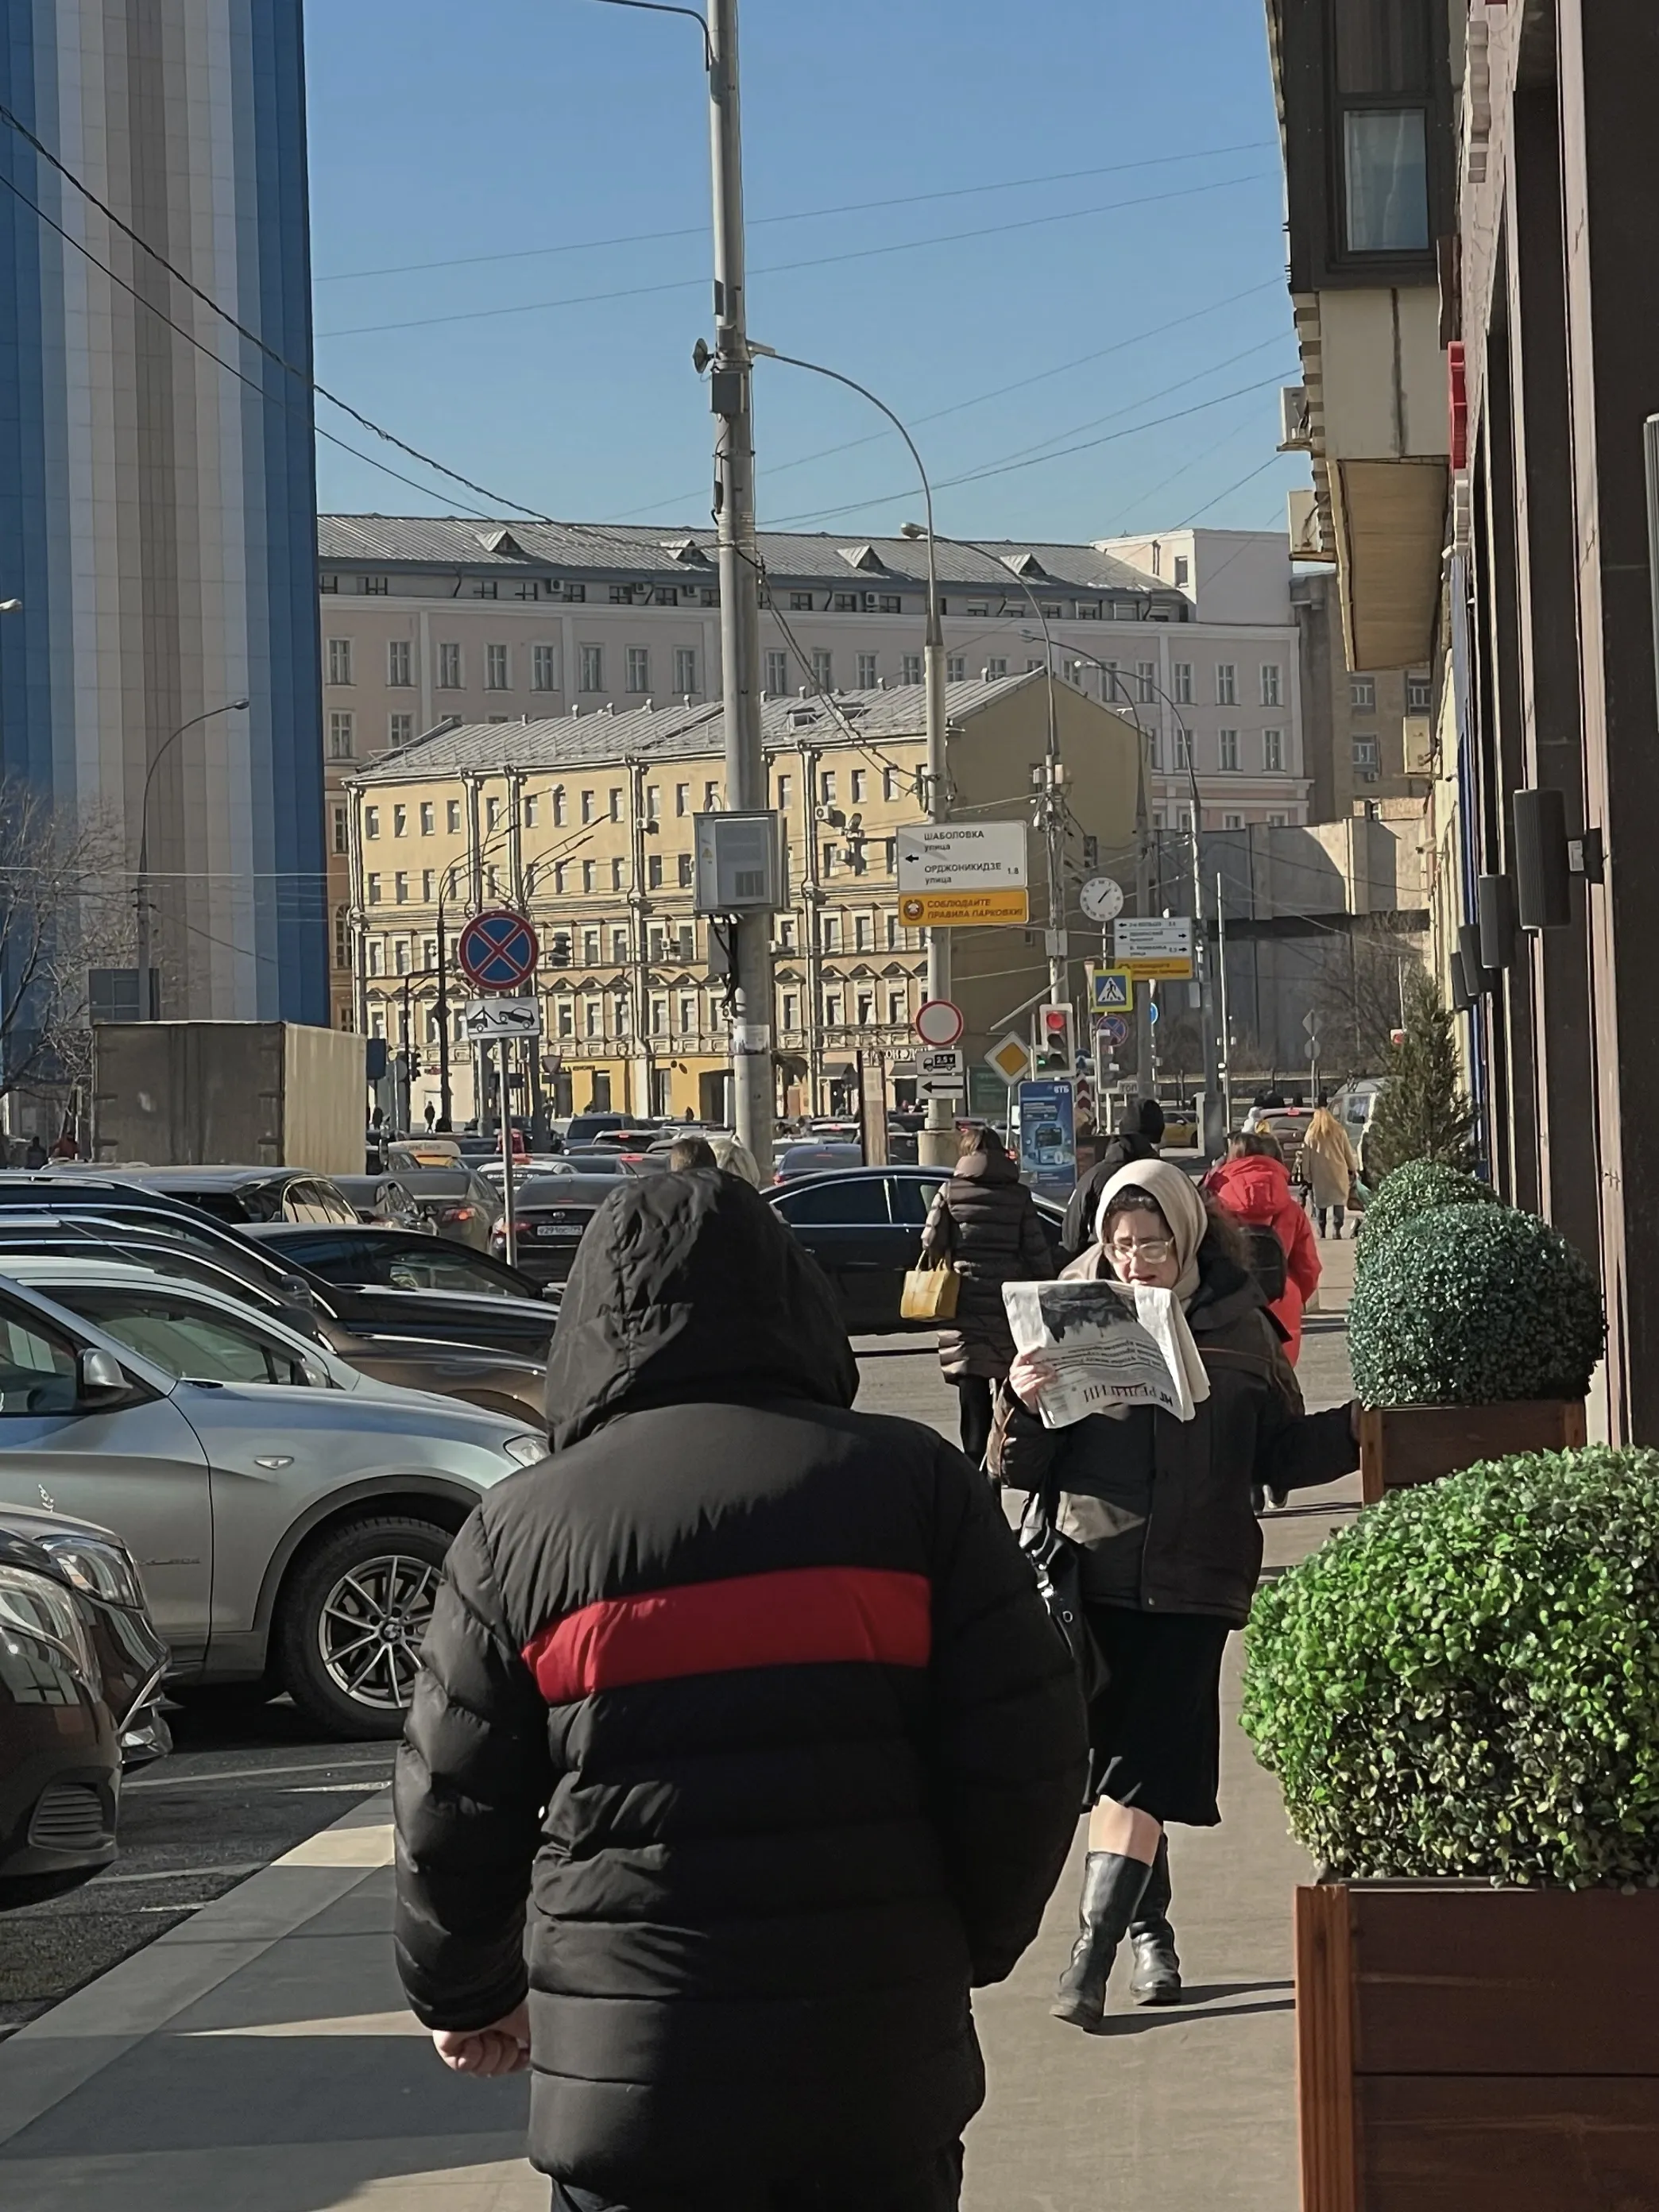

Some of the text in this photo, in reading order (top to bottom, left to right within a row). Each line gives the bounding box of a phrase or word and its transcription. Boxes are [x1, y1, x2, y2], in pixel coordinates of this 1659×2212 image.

[924, 830, 984, 841] ШАБОЛОВКА
[924, 843, 951, 853] улица
[924, 863, 1002, 873] ОРДЖОНИКИДЗЕ
[925, 876, 952, 885] улица
[927, 899, 992, 909] СОБЛЮДАЙТЕ
[927, 909, 970, 919] ПРАВИЛА
[1054, 1085, 1069, 1093] ВТБ
